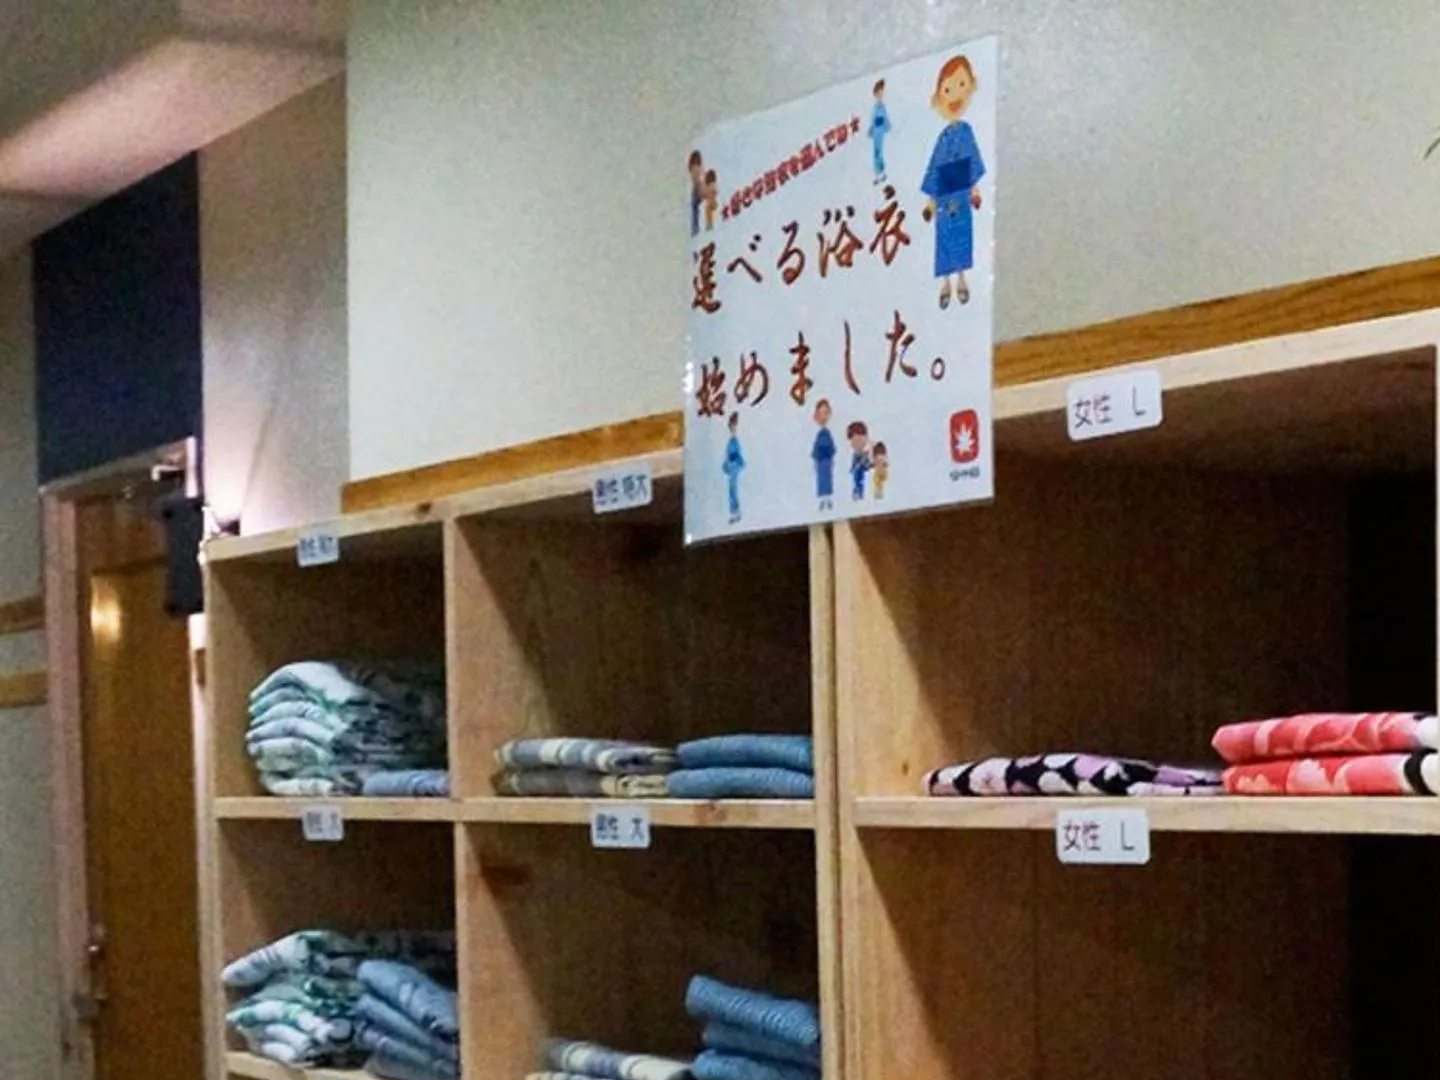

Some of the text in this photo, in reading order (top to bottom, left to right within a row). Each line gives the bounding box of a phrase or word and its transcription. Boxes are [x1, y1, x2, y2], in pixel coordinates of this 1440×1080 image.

[691, 184, 911, 315] 選べる浴衣
[695, 310, 945, 419] 始めました。
[1073, 384, 1146, 429] 女性 L
[1062, 817, 1136, 852] 女性 L
